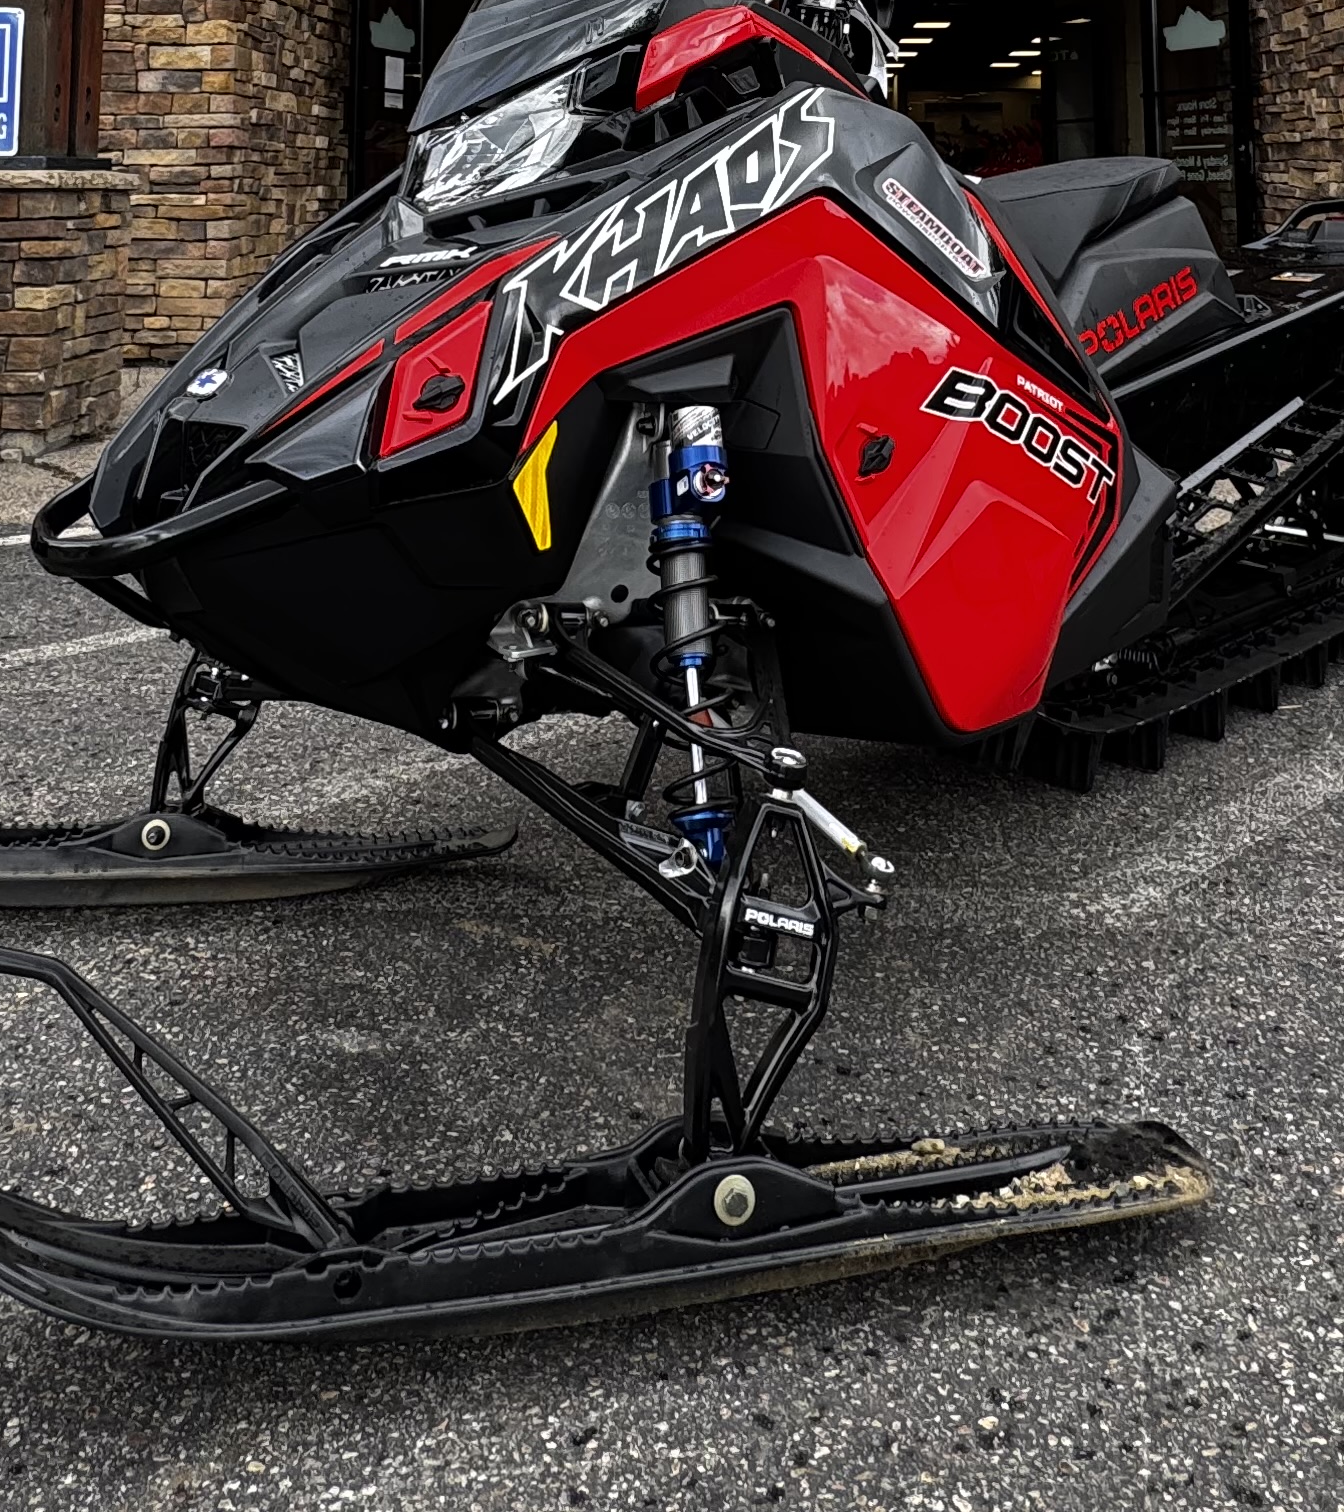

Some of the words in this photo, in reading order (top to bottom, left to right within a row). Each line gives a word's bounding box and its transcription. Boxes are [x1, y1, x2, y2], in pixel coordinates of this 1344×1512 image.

[492, 87, 836, 405] KHAOS
[885, 181, 985, 274] STEAMBOAT
[1077, 265, 1198, 356] POLARIS
[919, 365, 1116, 505] BOOST
[1016, 374, 1065, 413] PATRIOT
[744, 908, 815, 937] POLARIS
